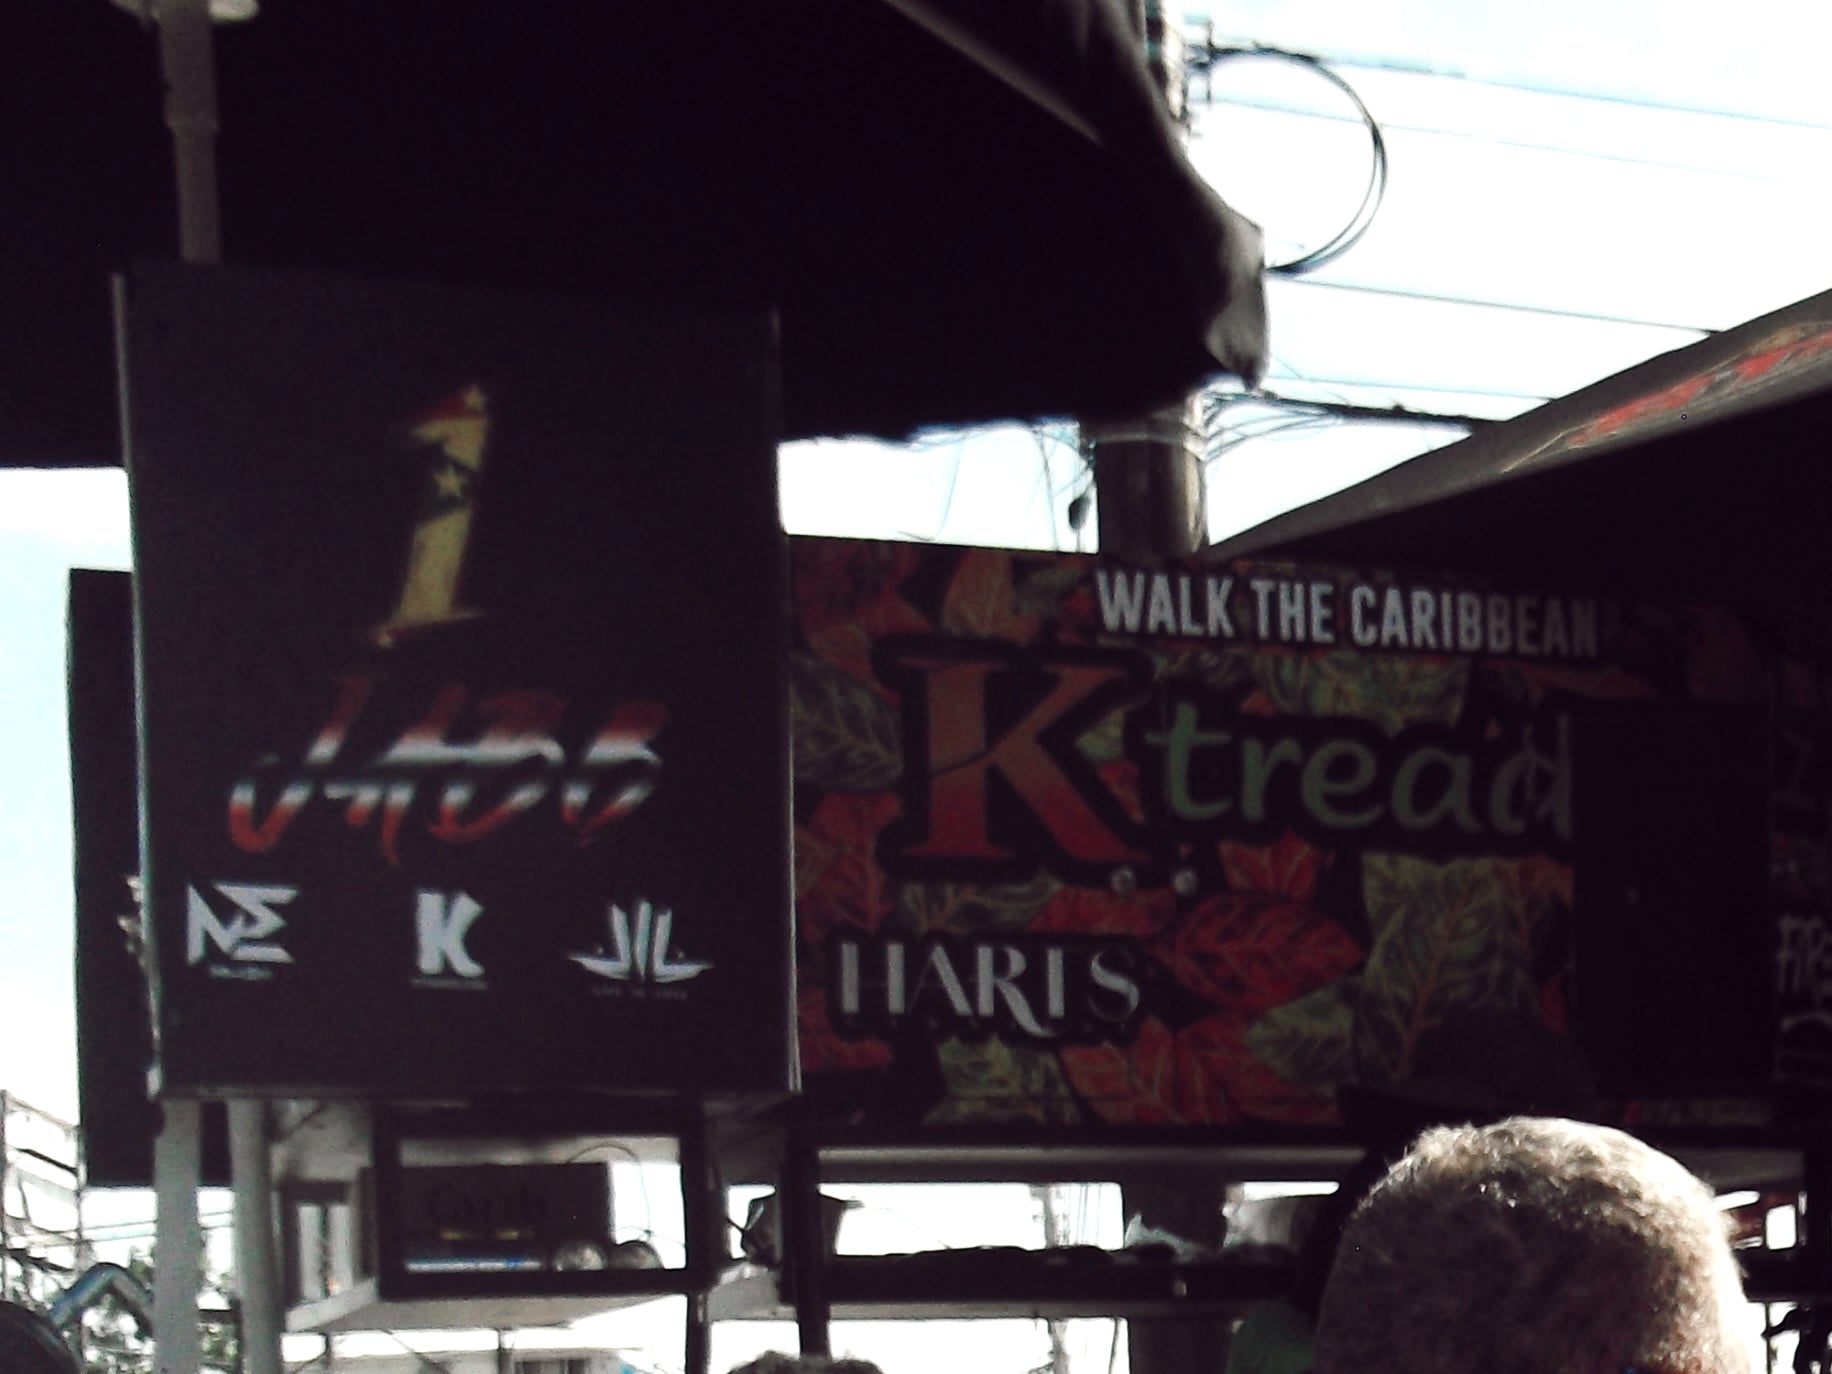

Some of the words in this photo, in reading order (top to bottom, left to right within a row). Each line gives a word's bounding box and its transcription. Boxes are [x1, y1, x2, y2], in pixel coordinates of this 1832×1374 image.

[1096, 569, 1236, 640] WALK
[1249, 578, 1335, 645] THE
[1350, 584, 1598, 658] CARIBBEAN
[902, 657, 1153, 863] K
[415, 887, 485, 978] K
